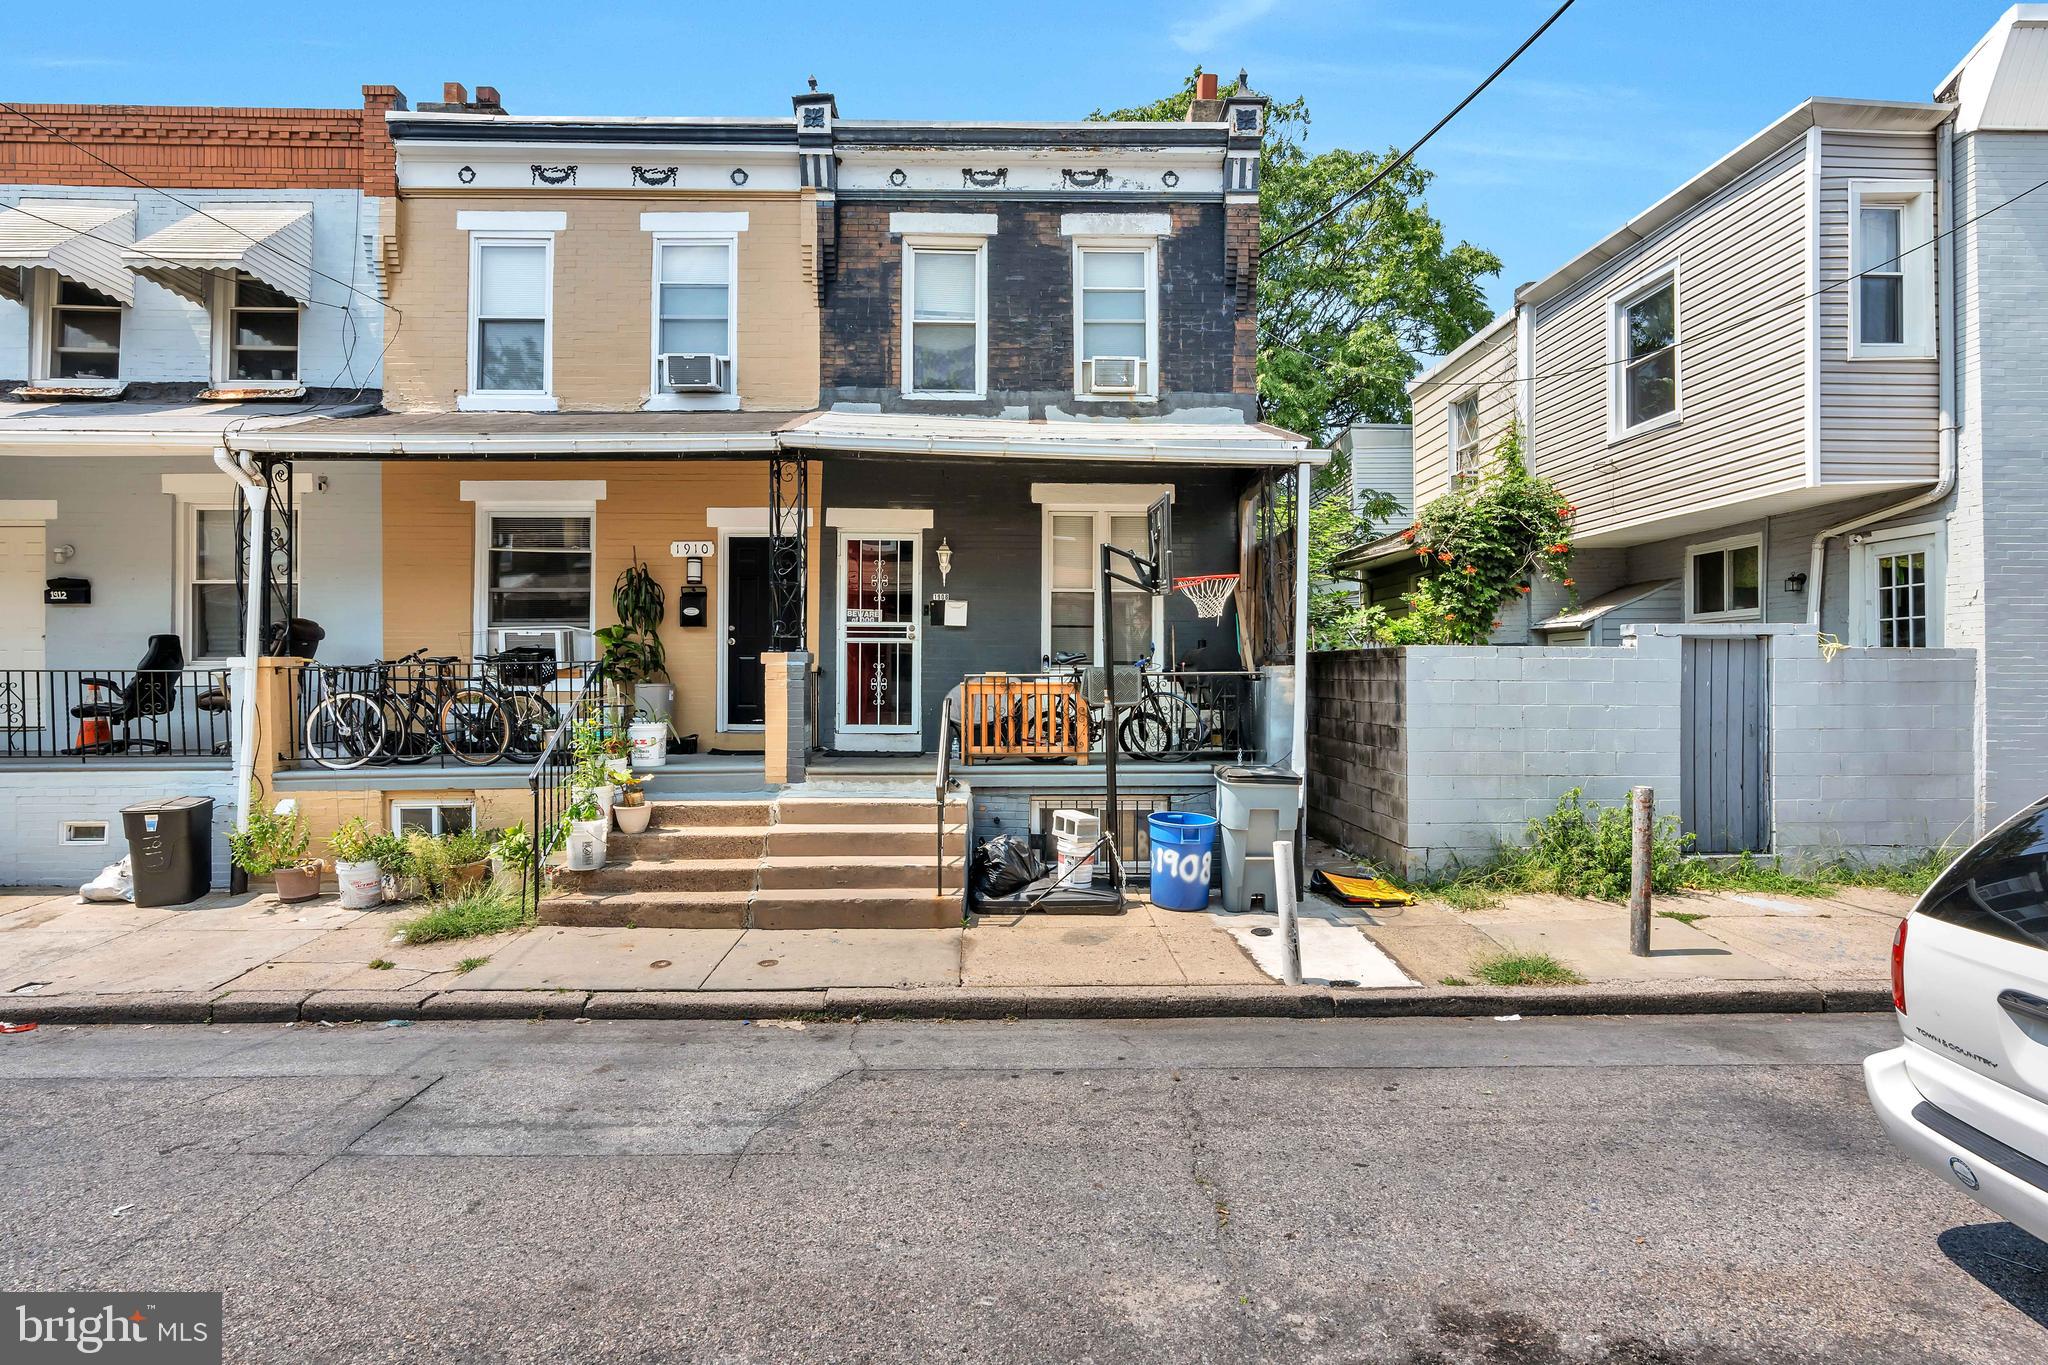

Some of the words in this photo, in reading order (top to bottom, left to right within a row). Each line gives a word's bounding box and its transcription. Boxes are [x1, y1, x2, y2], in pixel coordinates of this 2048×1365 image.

[676, 543, 709, 555] 1910
[50, 591, 68, 600] 1912
[847, 610, 880, 618] BEWARE
[1157, 847, 1212, 885] 1908
[1916, 1026, 1942, 1044] TOWN
[1948, 1042, 1998, 1068] COUNTRY
